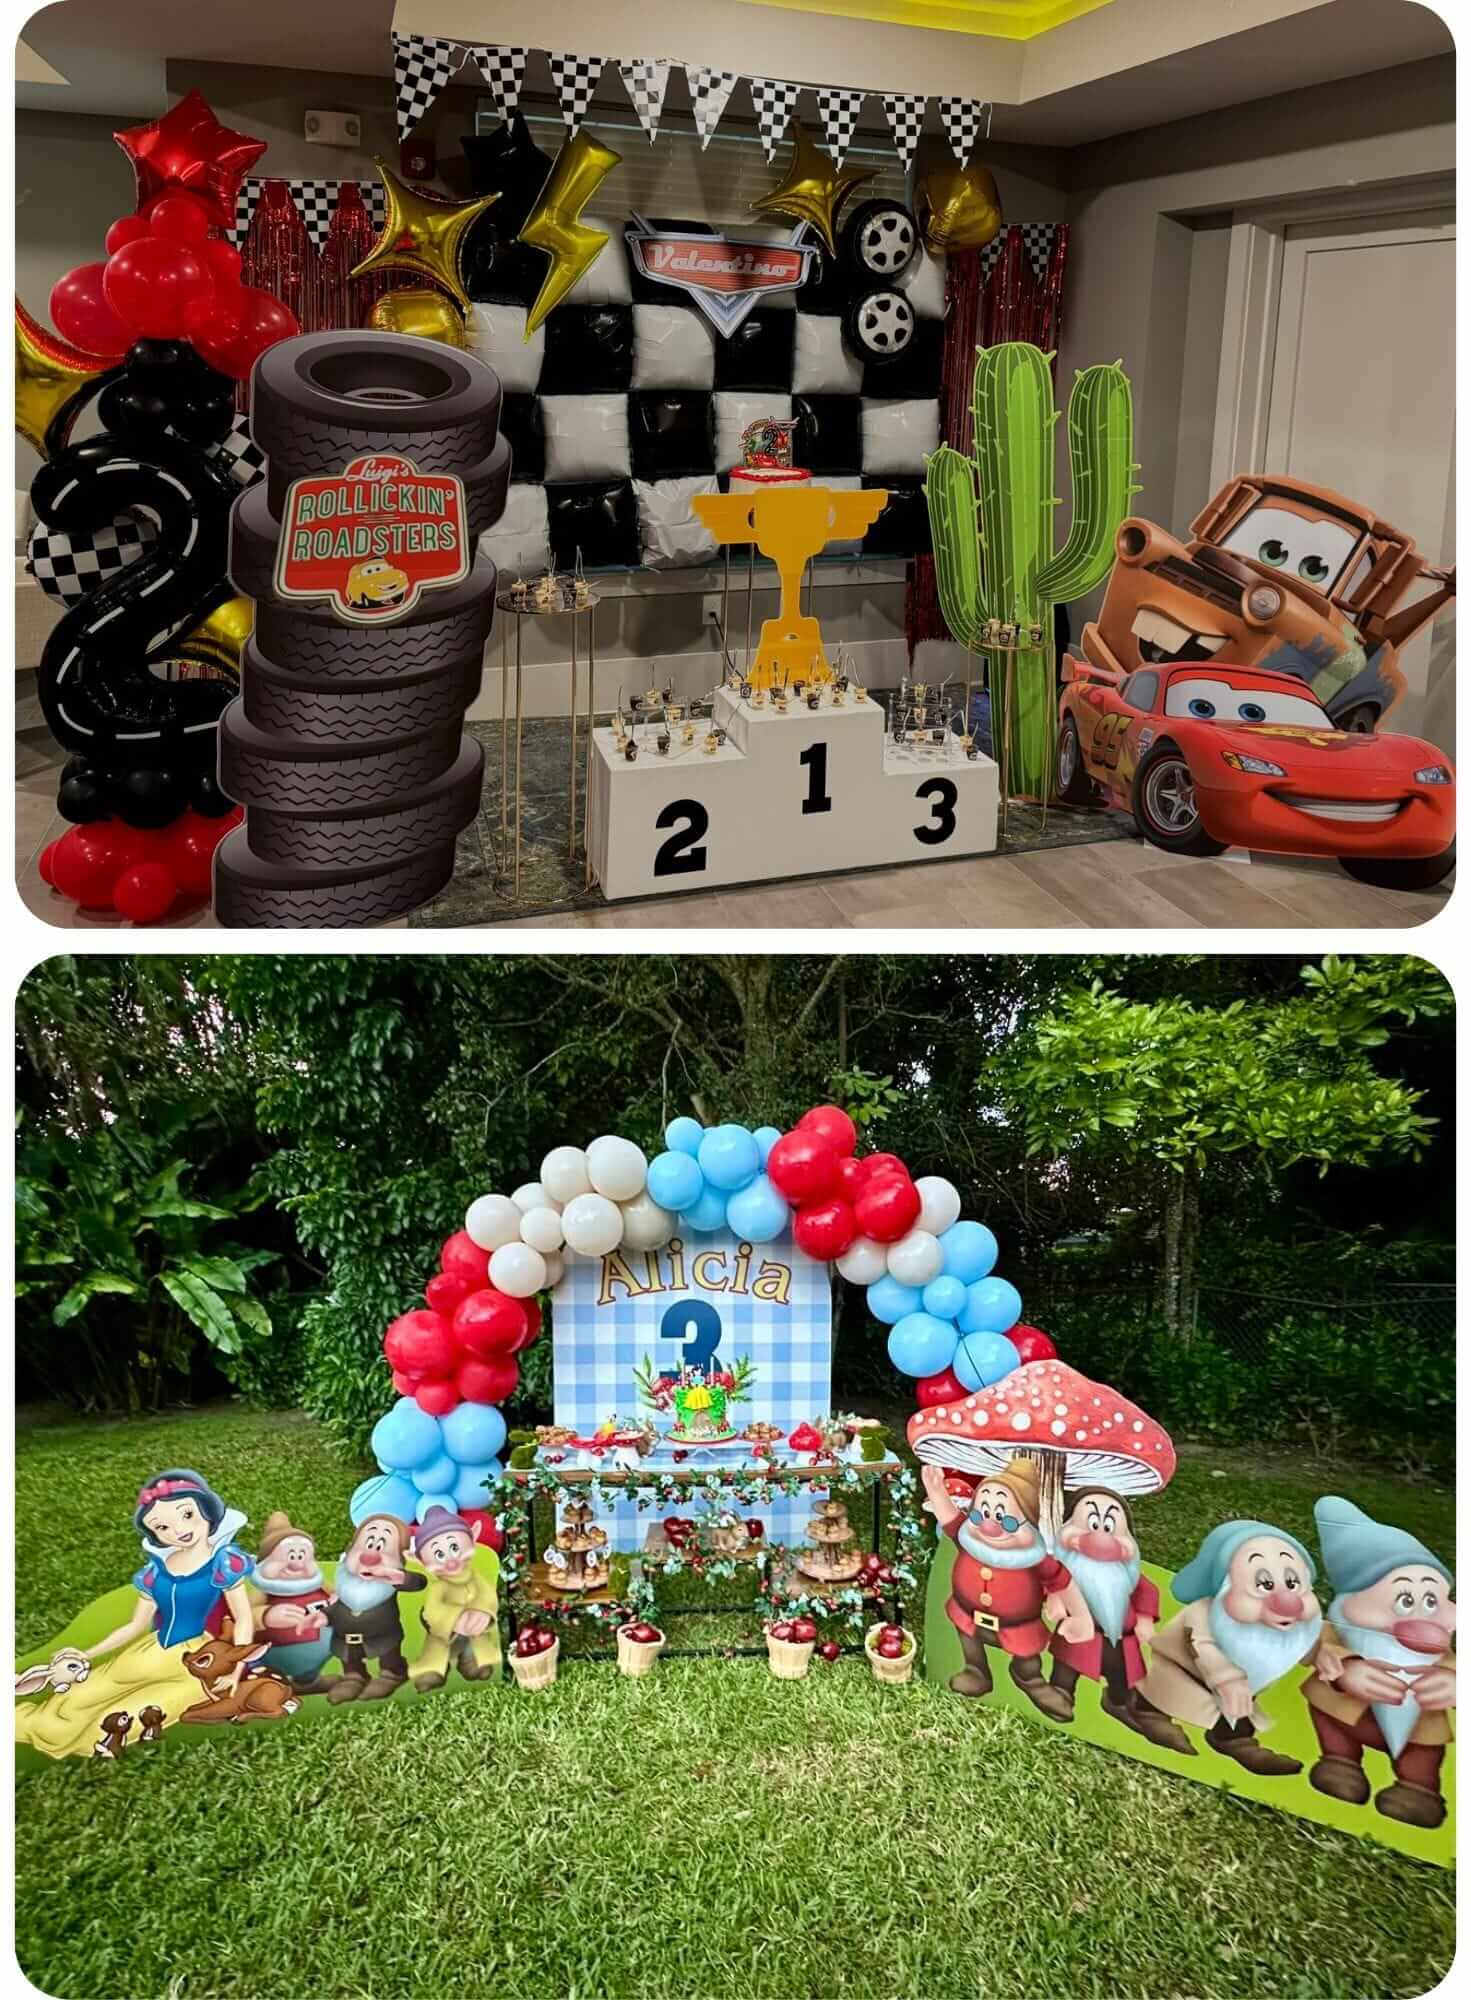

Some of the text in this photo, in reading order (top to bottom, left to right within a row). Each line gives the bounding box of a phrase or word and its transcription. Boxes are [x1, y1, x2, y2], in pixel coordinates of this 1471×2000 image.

[652, 244, 798, 278] Valentino
[346, 458, 411, 483] Luigi's
[296, 483, 455, 526] ROLLICKIN'
[292, 522, 458, 561] ROADSTERS
[31, 431, 243, 760] 2
[654, 742, 959, 877] 2 1 3
[597, 1238, 793, 1306] Alicia
[660, 1298, 724, 1382] 3
